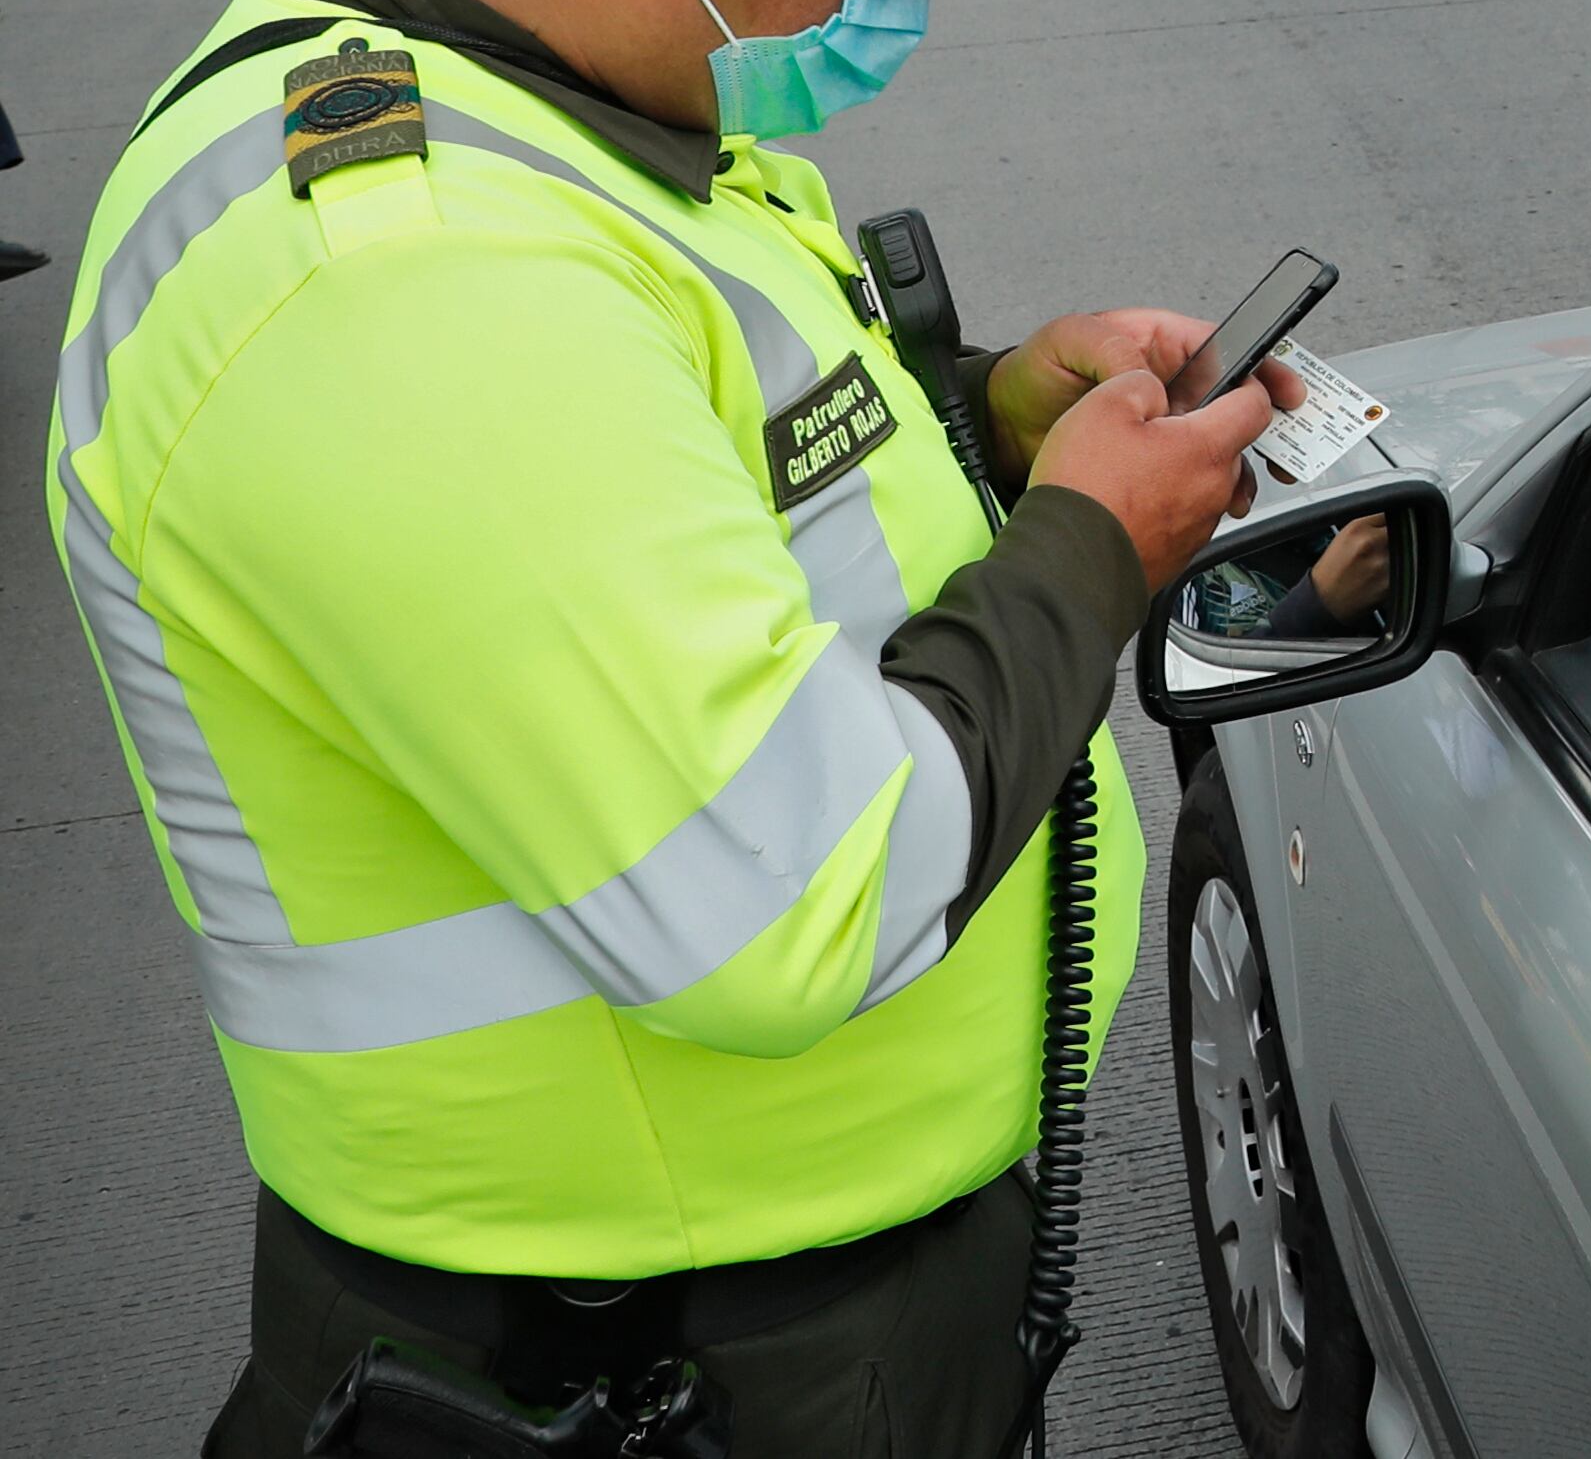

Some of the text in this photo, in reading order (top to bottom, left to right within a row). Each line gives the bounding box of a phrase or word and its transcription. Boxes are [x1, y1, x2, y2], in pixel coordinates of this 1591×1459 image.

[313, 131, 405, 171] DITRA
[786, 396, 887, 486] GILBERTO ROJAS
[791, 378, 865, 447] Patrullero
